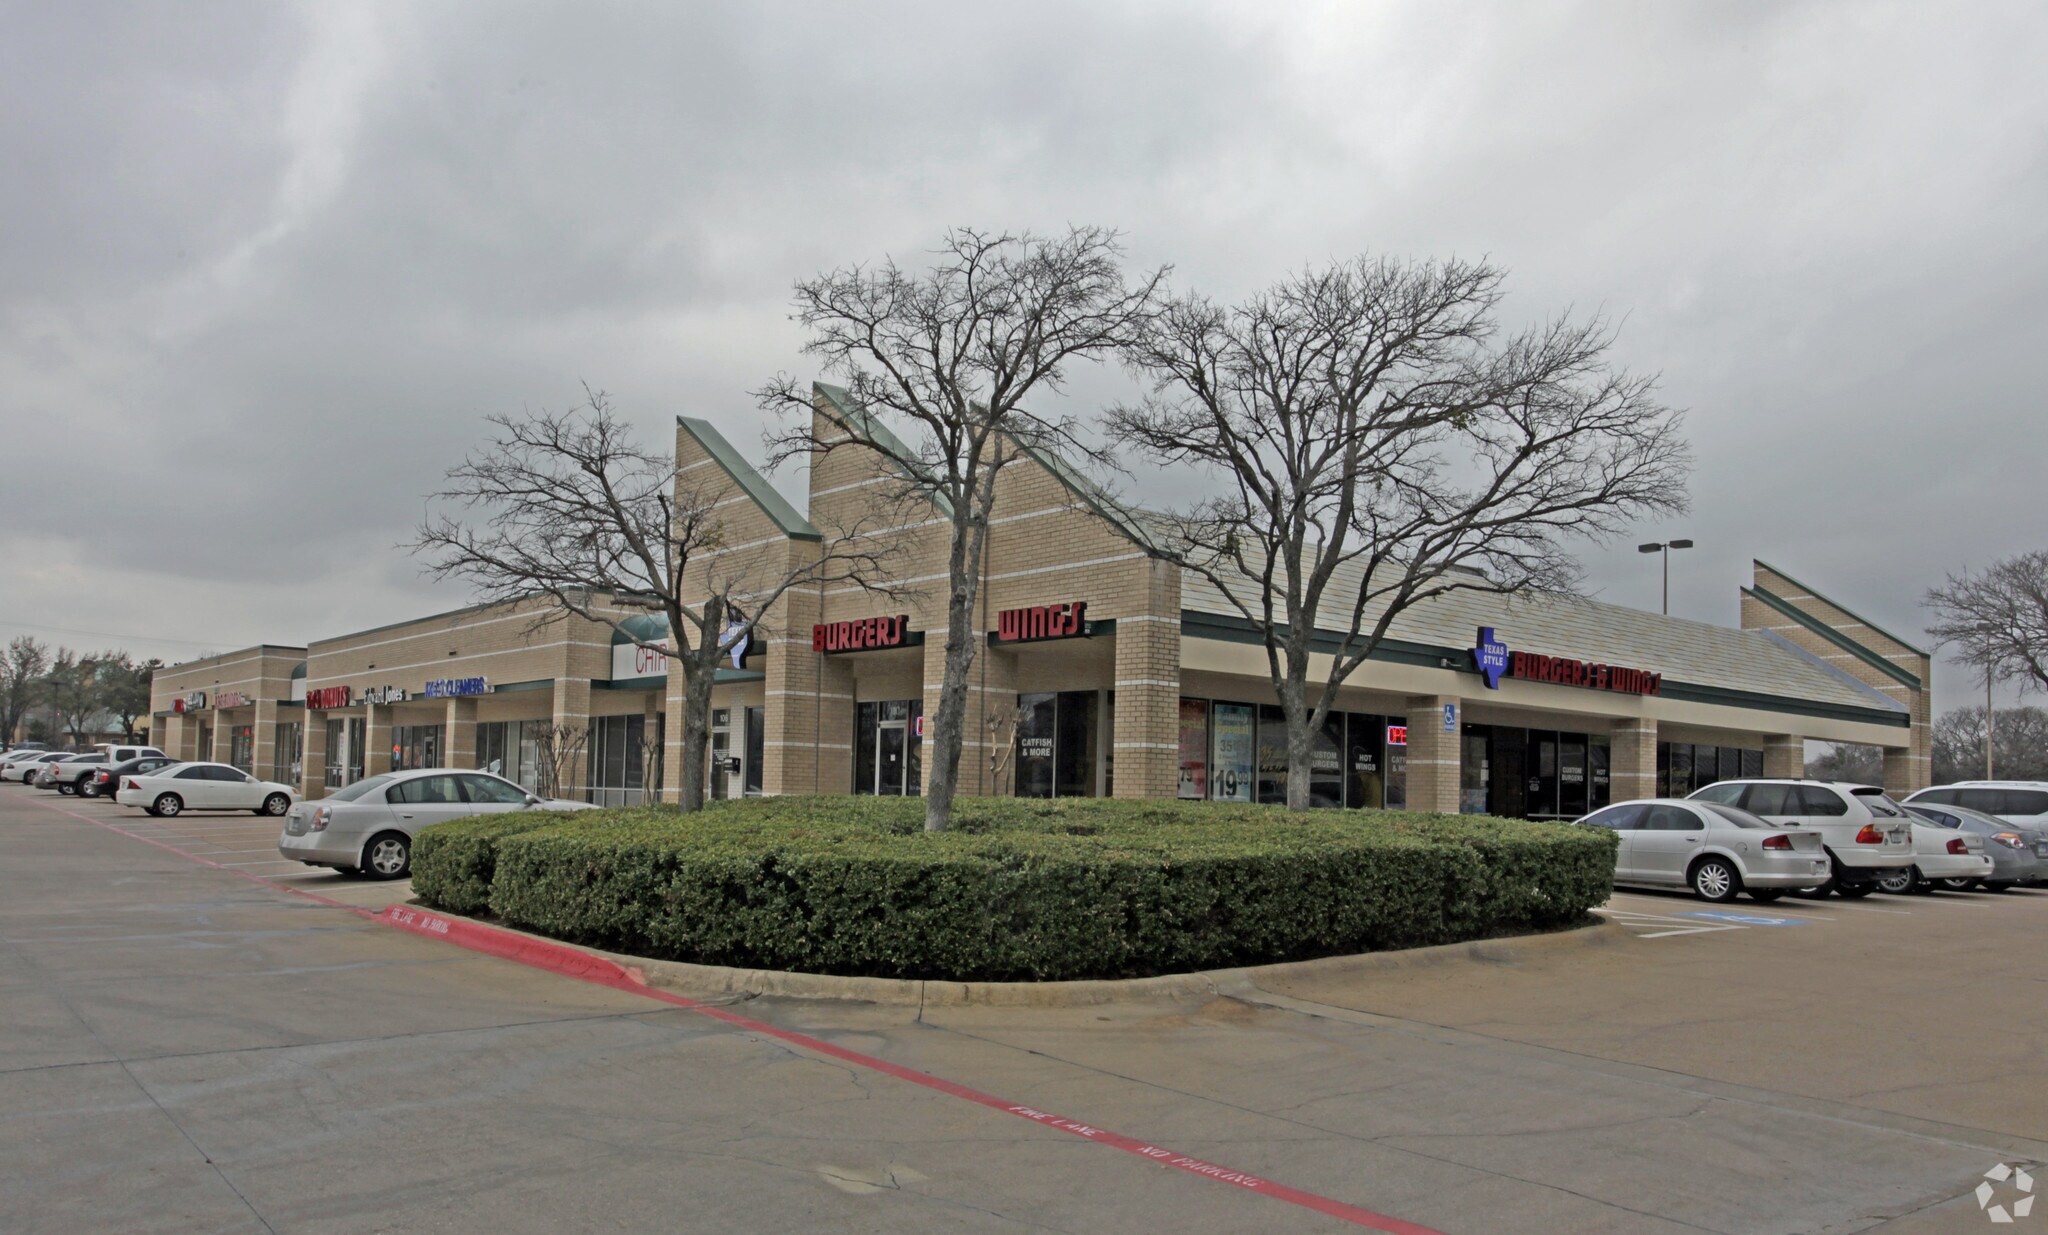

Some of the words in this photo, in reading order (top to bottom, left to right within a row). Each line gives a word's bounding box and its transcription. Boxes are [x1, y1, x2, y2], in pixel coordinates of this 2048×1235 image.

[998, 601, 1085, 641] WINGS
[812, 615, 907, 652] BURGERS
[1483, 644, 1505, 655] TEXAS
[1483, 655, 1504, 666] STYLE
[1514, 651, 1594, 687] BURGERS
[1611, 666, 1662, 696] WINGS
[446, 676, 485, 695] CLEANERS
[320, 686, 347, 708] DONUTS
[363, 687, 384, 705] Edward
[384, 685, 403, 705] Jones
[1388, 727, 1408, 744] OPE
[1021, 738, 1052, 748] CATFISH
[1022, 747, 1028, 757] &
[1029, 748, 1051, 757] MORE
[1313, 750, 1337, 760] USTOM
[1358, 754, 1373, 762] HOT
[1312, 760, 1339, 769] URGERS
[1355, 762, 1376, 771] WINGS
[1562, 766, 1583, 774] CUSTOM
[1215, 769, 1237, 797] 19
[1561, 774, 1584, 782] BURGERS
[1009, 1106, 1055, 1120] FIRE
[1052, 1117, 1104, 1137] LANE
[1138, 1146, 1171, 1158] NO
[1172, 1157, 1263, 1187] PARKING
